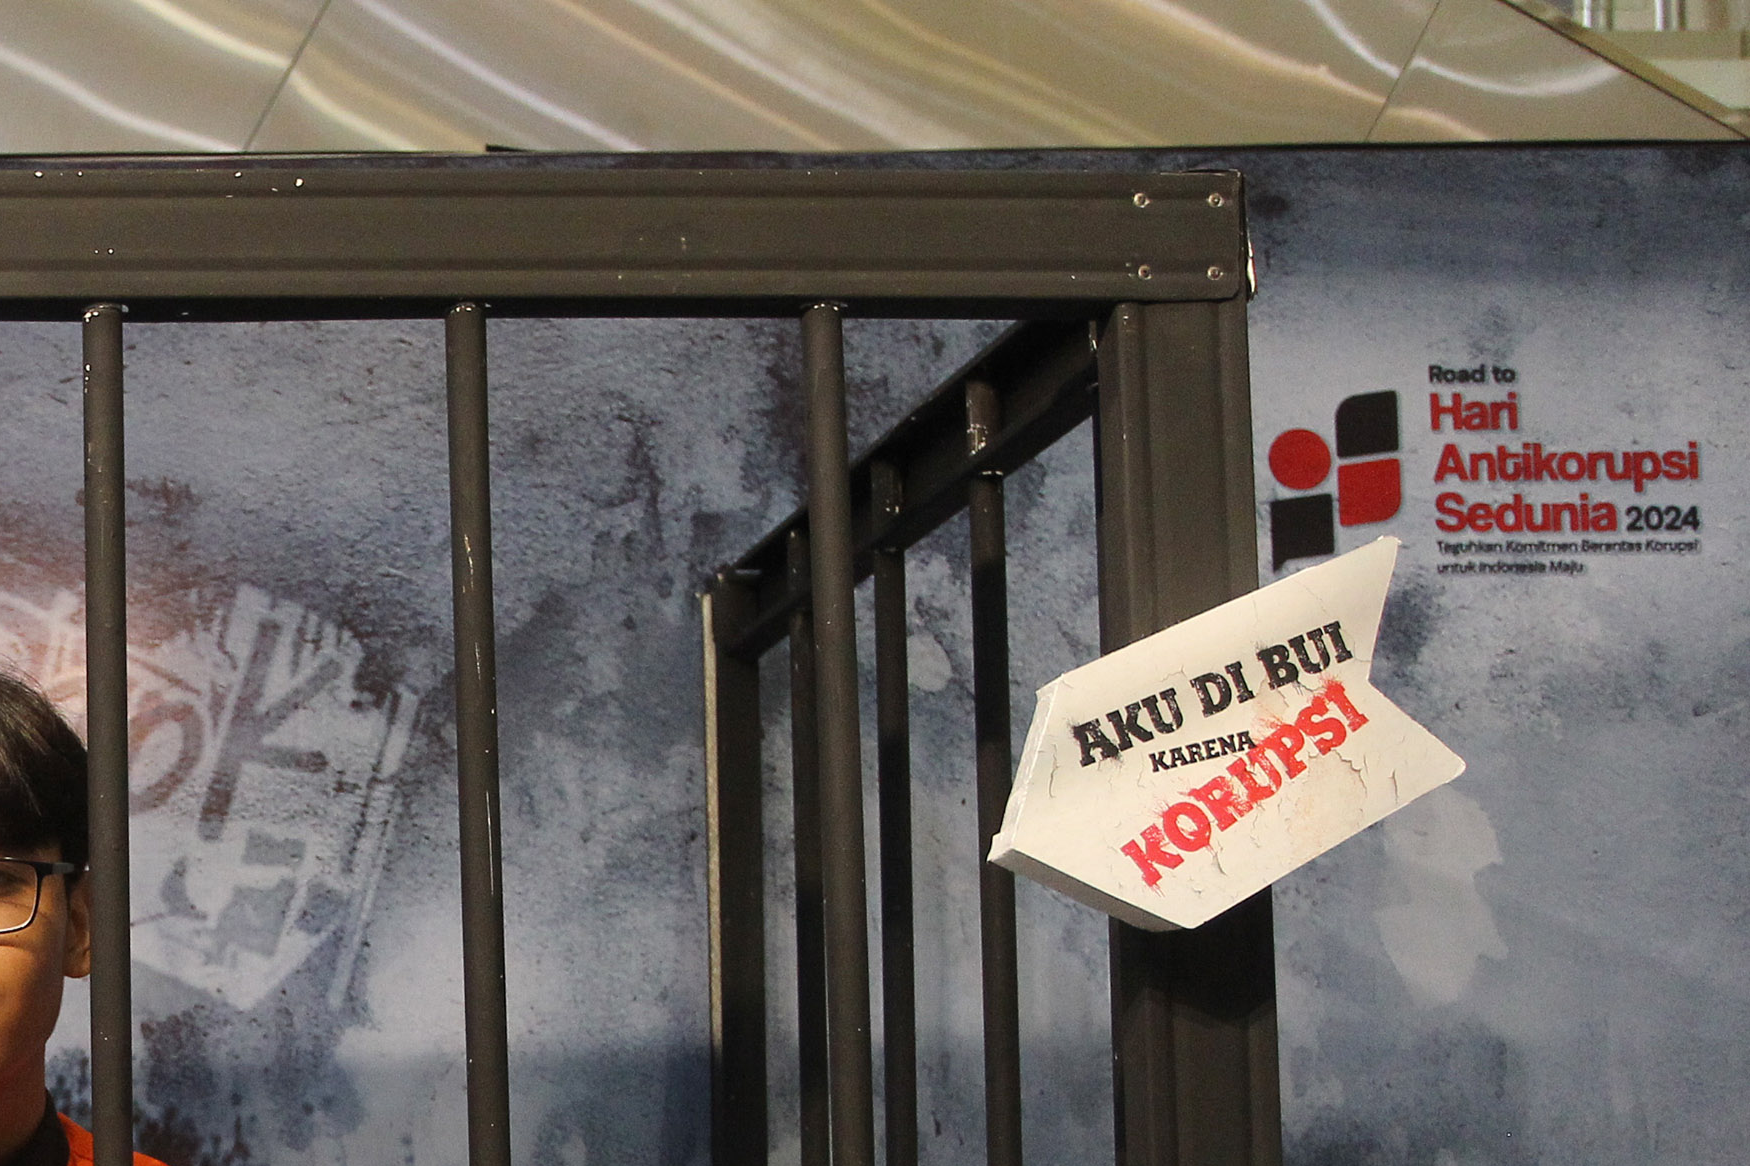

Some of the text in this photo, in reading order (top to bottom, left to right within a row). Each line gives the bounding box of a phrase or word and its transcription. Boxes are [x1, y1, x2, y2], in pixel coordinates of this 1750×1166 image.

[1428, 365, 1516, 384] Road to
[1429, 392, 1519, 431] Hari
[1434, 441, 1700, 493] Antikorupsi
[1435, 492, 1700, 533] Sedunia 2024
[1437, 539, 1700, 556] Teguhkan Komitmen Berantas Korupsi
[1437, 560, 1584, 576] untuk Indonesia Maju
[1073, 621, 1354, 767] AKU DI BUI
[1150, 730, 1258, 773] KARENA
[1120, 682, 1369, 887] KORUPSI
